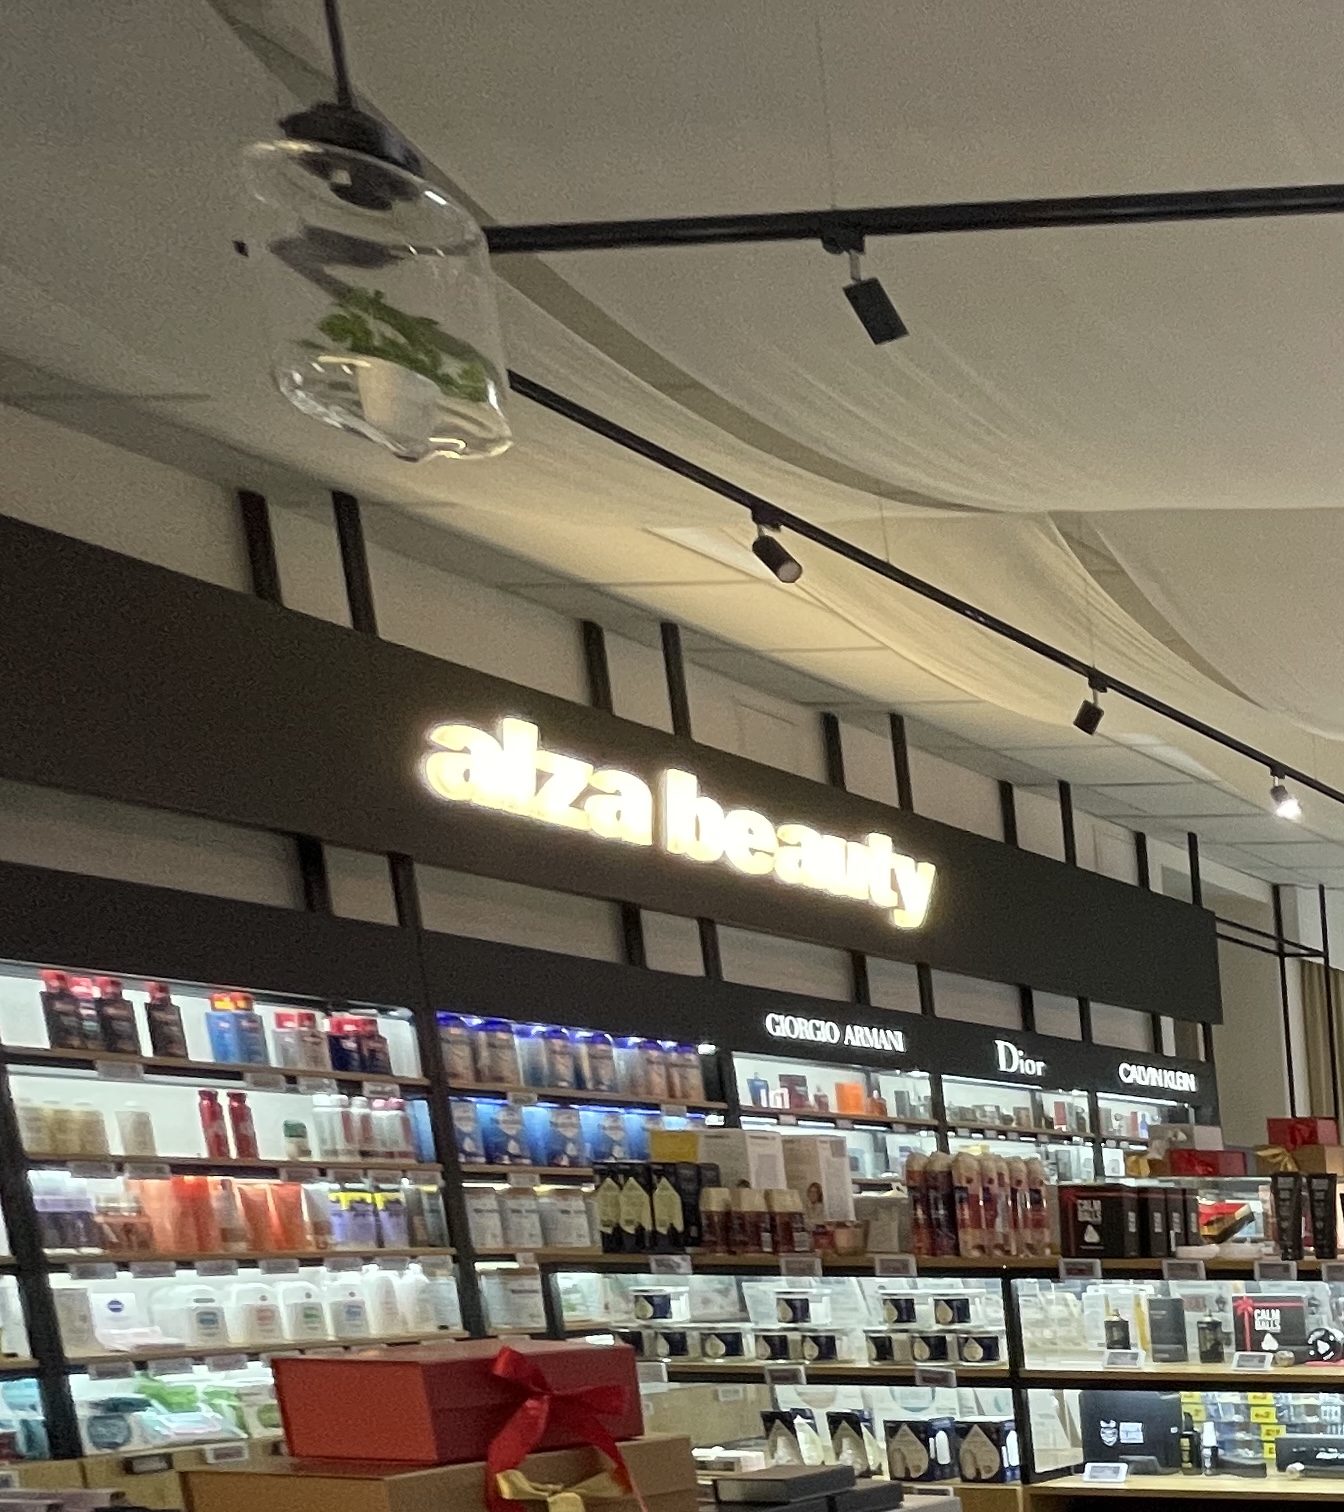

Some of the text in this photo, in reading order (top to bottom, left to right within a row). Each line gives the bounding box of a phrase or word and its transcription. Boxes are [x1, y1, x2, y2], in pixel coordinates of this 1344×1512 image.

[425, 717, 937, 930] alza beauty
[765, 1012, 906, 1053] GIORGIO ARMANI
[995, 1039, 1046, 1077] Dior
